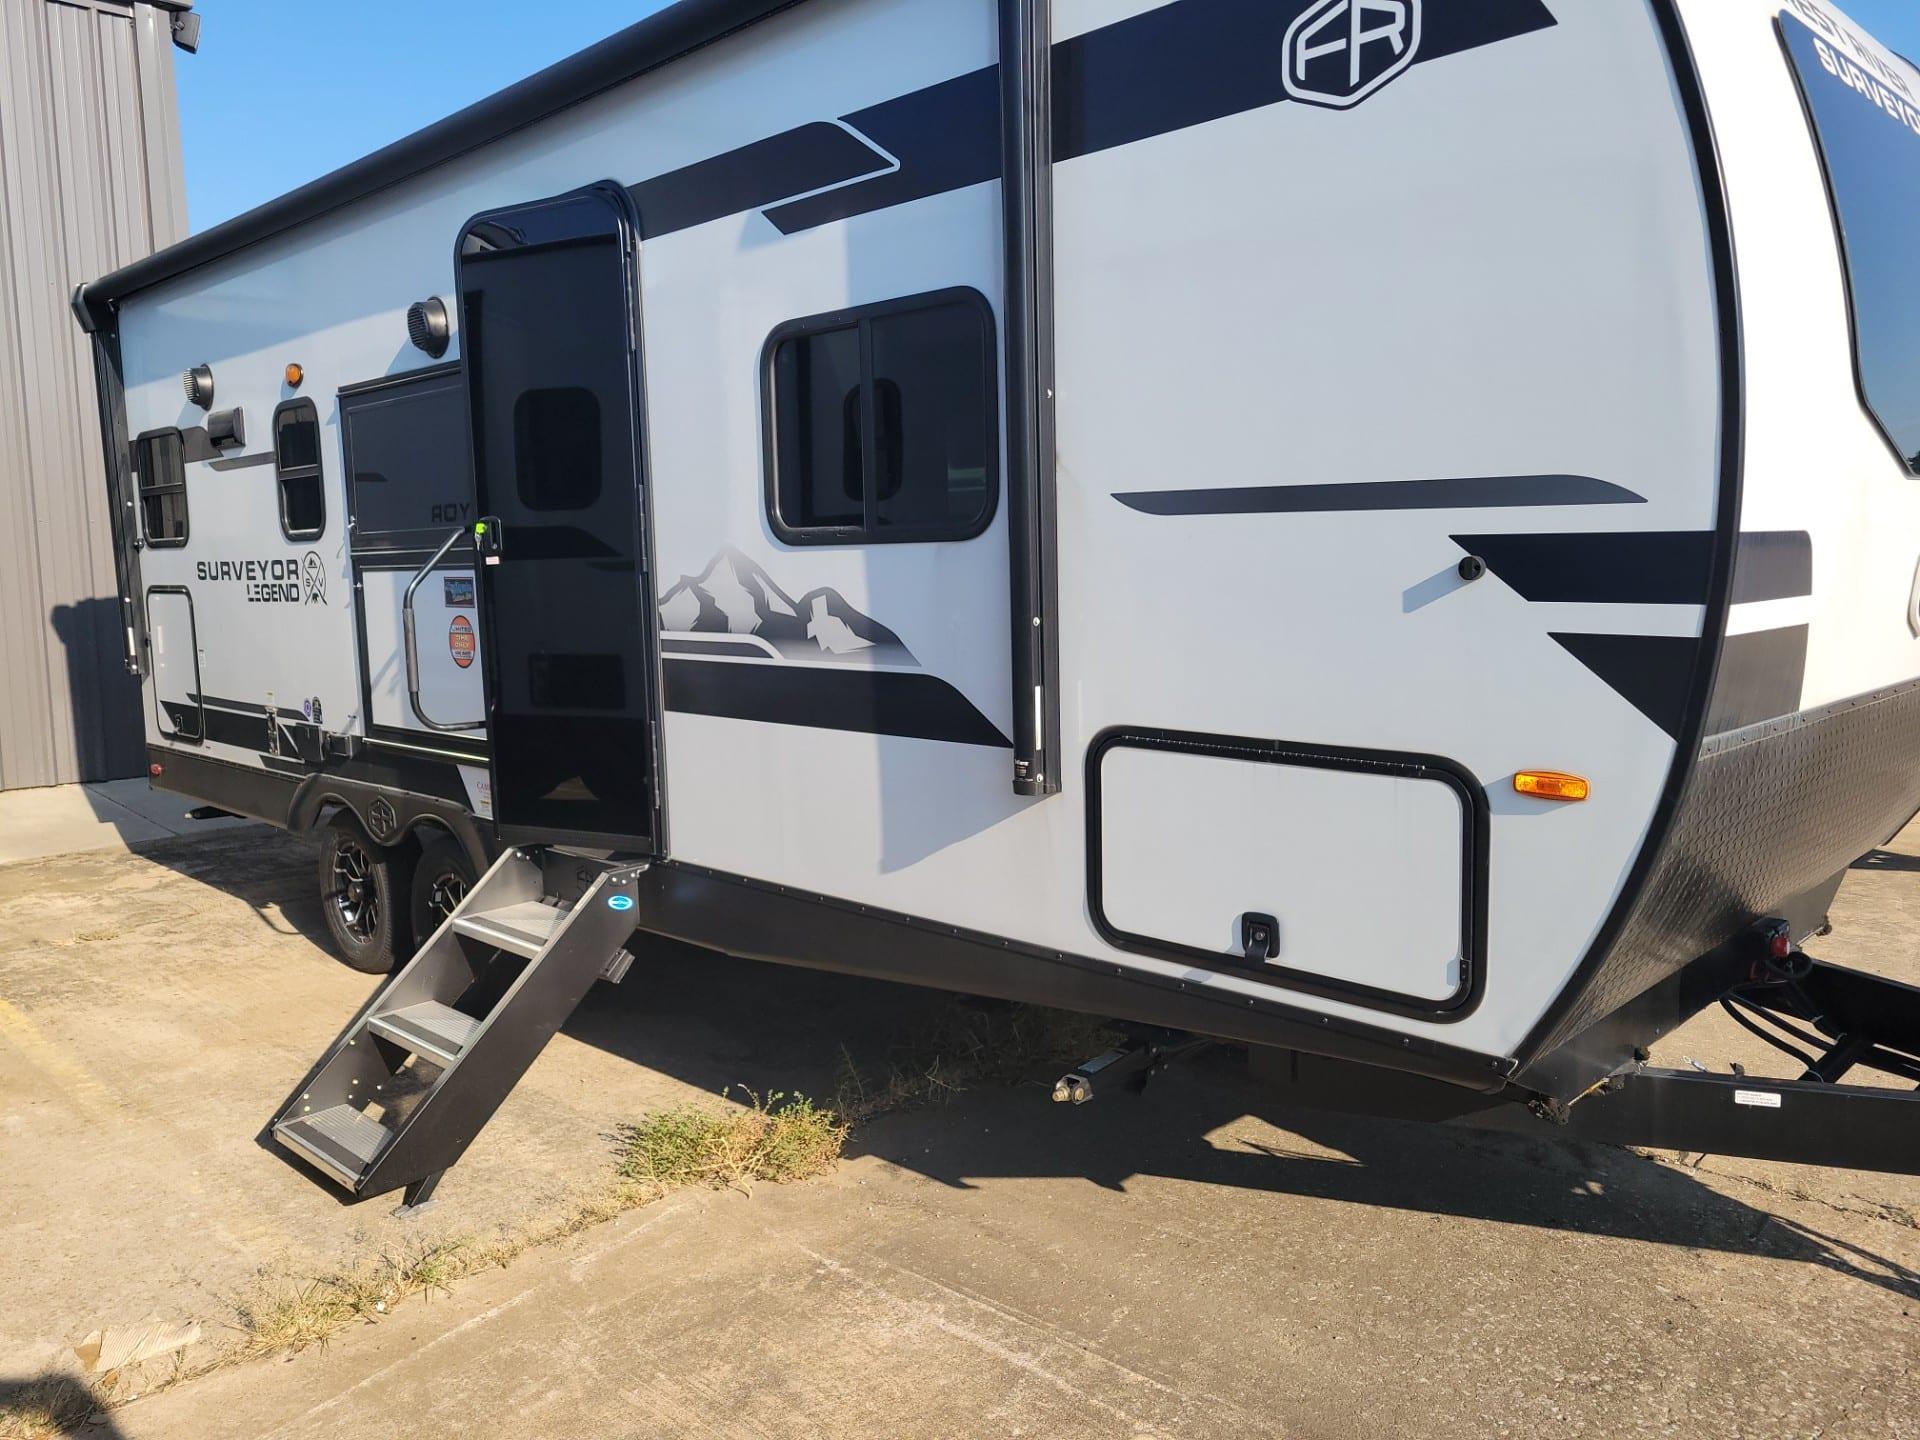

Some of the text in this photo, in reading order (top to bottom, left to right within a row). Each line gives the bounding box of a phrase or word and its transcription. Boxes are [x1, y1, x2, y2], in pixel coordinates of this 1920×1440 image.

[1296, 0, 1405, 87] FR
[1840, 27, 1918, 103] RIVER
[196, 560, 299, 580] SURVEYOR
[246, 584, 299, 602] LEGEND
